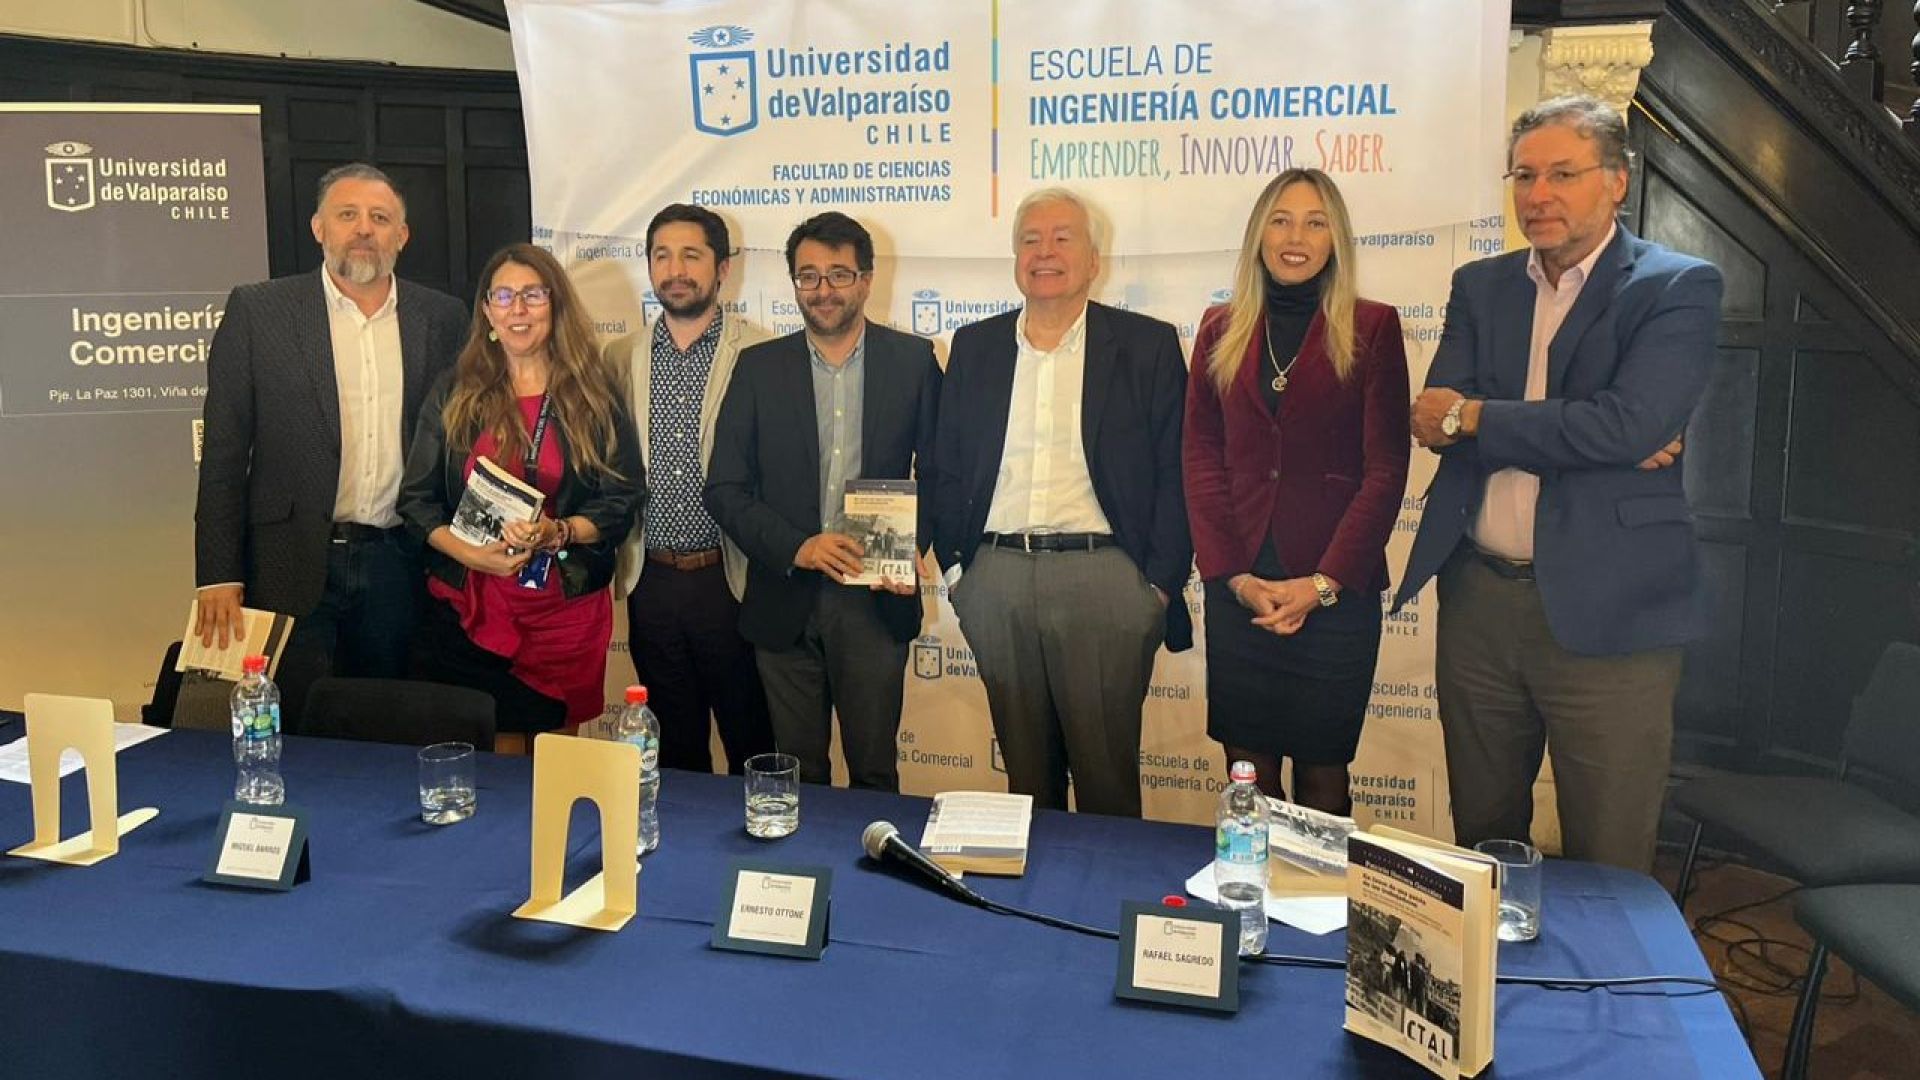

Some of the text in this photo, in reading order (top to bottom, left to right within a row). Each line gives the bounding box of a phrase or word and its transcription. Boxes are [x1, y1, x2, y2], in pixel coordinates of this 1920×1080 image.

[767, 42, 950, 78] Universidad
[1030, 43, 1213, 81] ESCUELA DE
[1029, 83, 1396, 126] INGENIERÍA COMERCIAL
[867, 123, 951, 145] CHILE
[1031, 138, 1171, 181] EMPRENDER,
[1315, 129, 1393, 173] SABER.
[99, 157, 228, 178] Universidad
[773, 160, 951, 181] FACULTAD DE CIENCIAS
[693, 185, 951, 207] ECONÓMICAS Y ADMINISTRATIVAS
[171, 206, 230, 219] CHILE
[70, 339, 212, 365] Comerci
[49, 389, 72, 403] Pje.
[76, 388, 91, 400] La
[95, 387, 118, 400] Paz
[160, 385, 187, 398] Viña
[911, 751, 973, 769] Comercial
[1194, 756, 1209, 771] de
[741, 904, 805, 919] ERNESTO OTTONE
[1142, 948, 1173, 961] RAFAEL
[1406, 1019, 1448, 1061] CTAL
